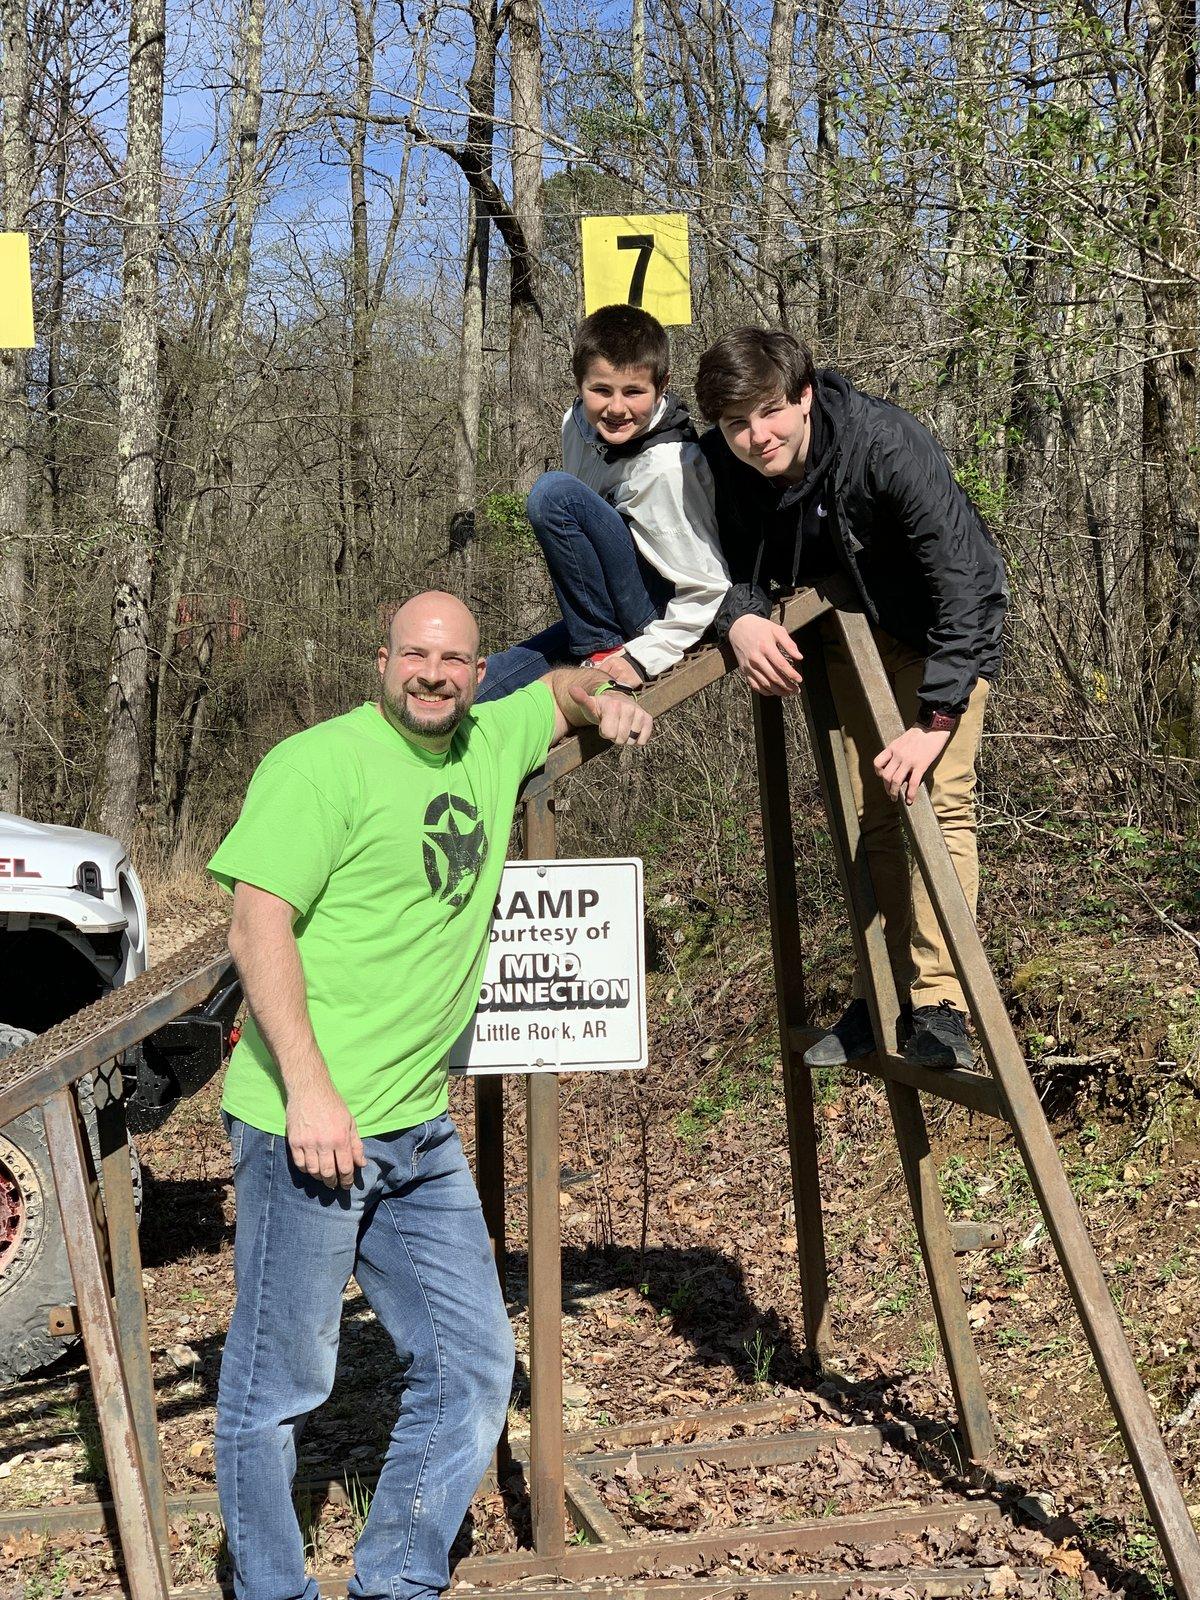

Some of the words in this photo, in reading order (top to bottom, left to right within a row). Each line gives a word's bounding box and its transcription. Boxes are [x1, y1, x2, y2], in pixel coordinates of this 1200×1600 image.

[617, 234, 654, 308] 7
[586, 921, 610, 940] of
[500, 953, 581, 983] MUD
[476, 1023, 520, 1042] Little
[583, 1020, 607, 1038] AR
